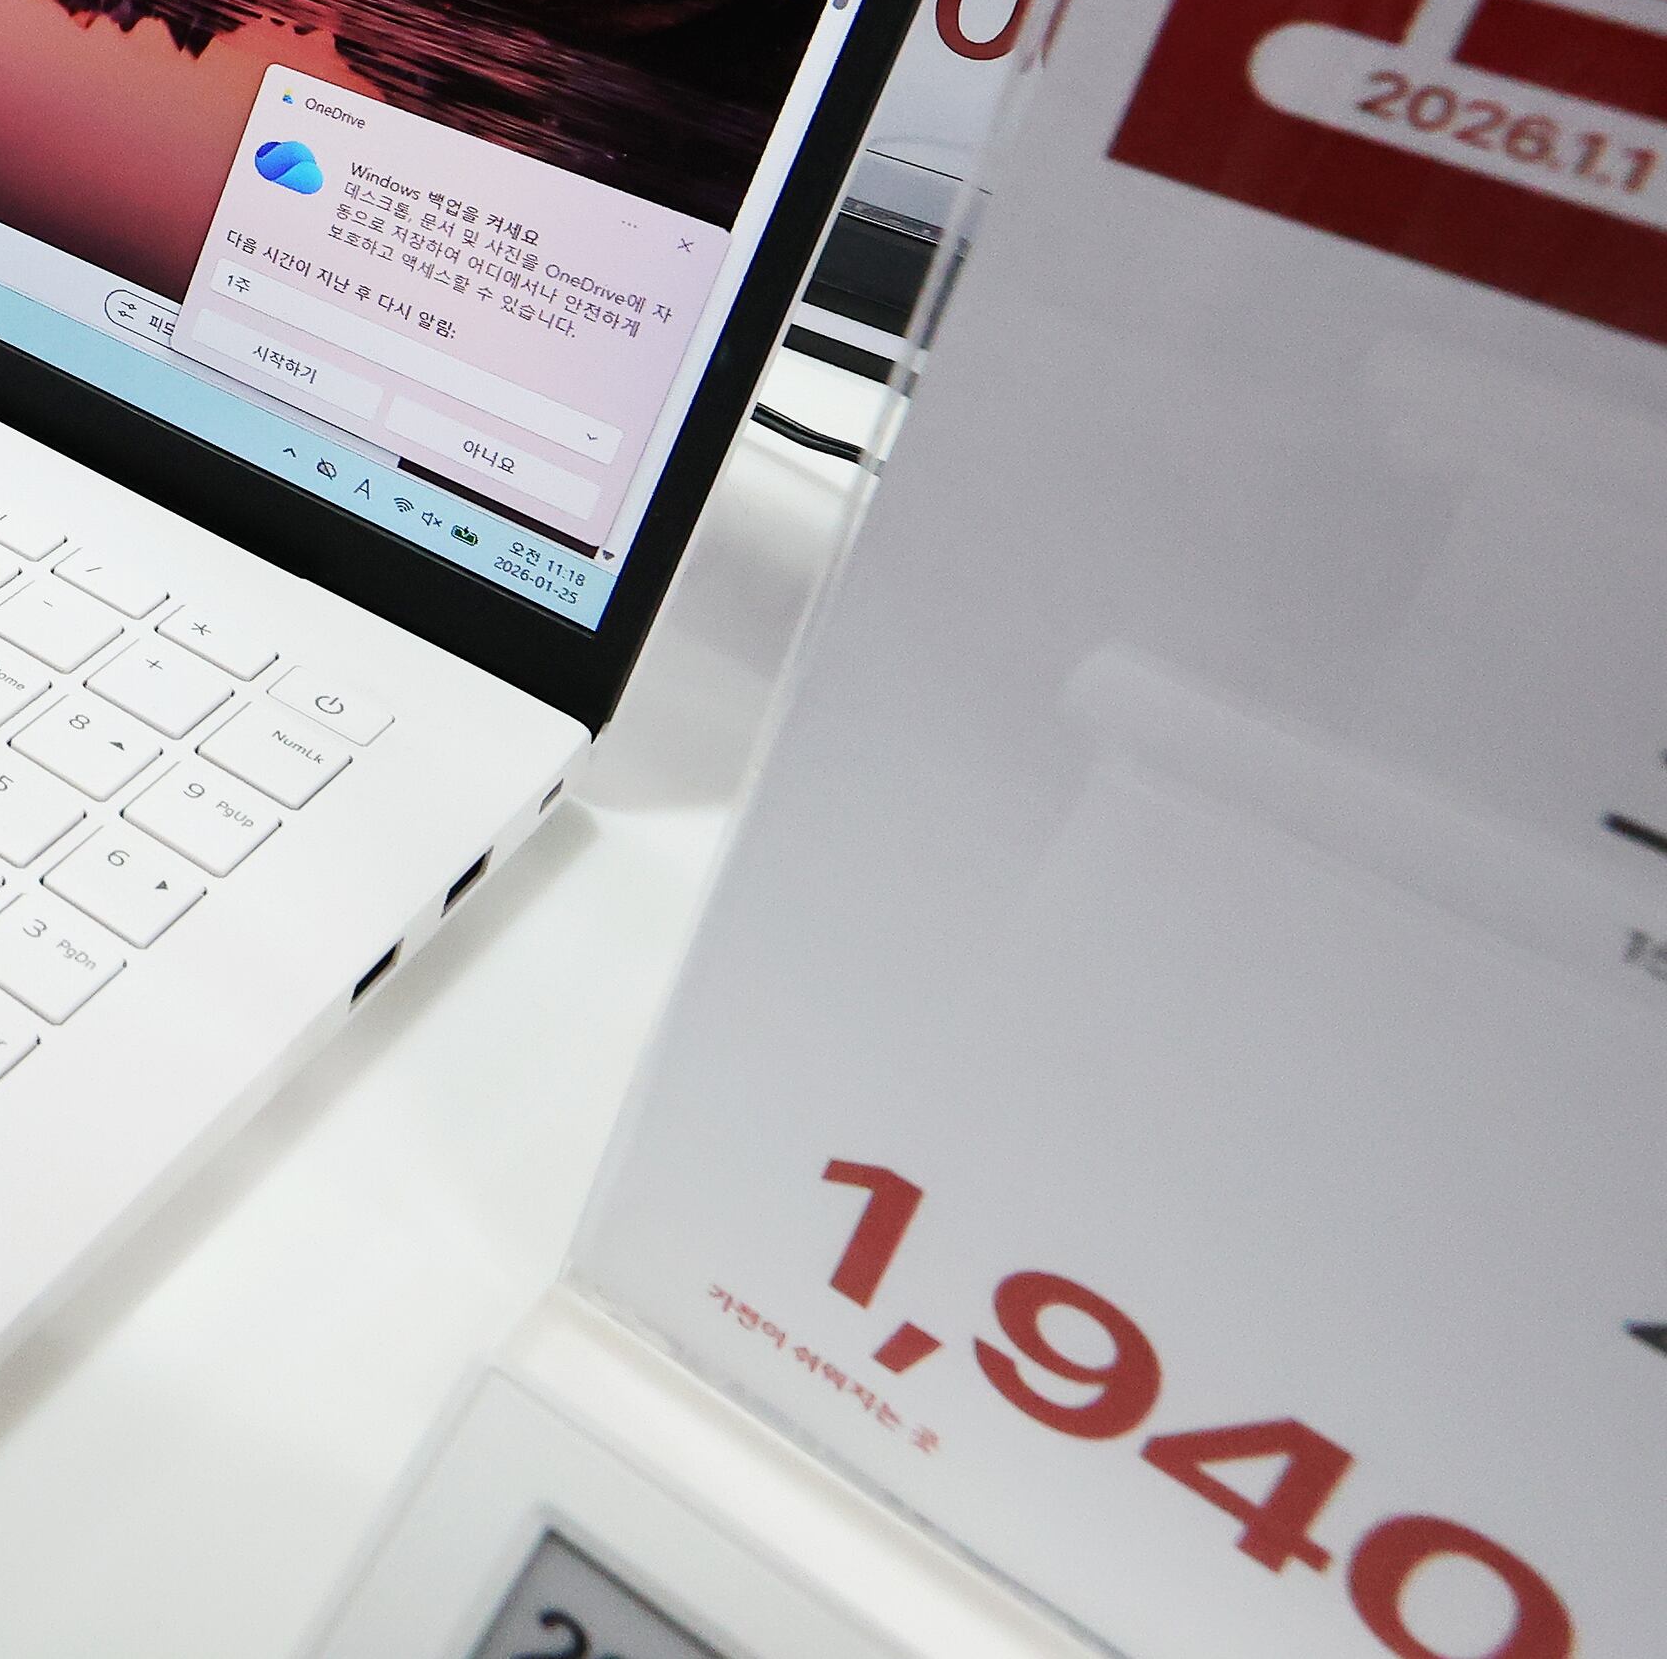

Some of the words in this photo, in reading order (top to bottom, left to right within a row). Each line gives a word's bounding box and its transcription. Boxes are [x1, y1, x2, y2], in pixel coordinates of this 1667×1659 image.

[304, 96, 366, 130] OneDrive
[1354, 69, 1661, 196] 2026.1.1
[350, 160, 421, 202] Windows
[427, 188, 480, 224] 백업을
[486, 212, 540, 248] 켜세요
[225, 230, 257, 255] 다음
[261, 244, 312, 279] 시간이
[316, 267, 349, 298] 지난
[356, 285, 371, 303] 후
[377, 291, 413, 321] 다시
[225, 272, 252, 295] 1주
[327, 222, 395, 263] 보호하고
[402, 250, 472, 293] 액세스할
[479, 285, 493, 301] 수
[501, 293, 577, 340] 있습니다.
[335, 200, 386, 235] 동으로
[392, 223, 462, 267] 저장하여
[467, 253, 559, 304] 어디에서나
[565, 289, 641, 339] 안전하게
[419, 209, 455, 240] 문서
[463, 228, 477, 246] 및
[484, 238, 539, 273] 사진을
[545, 263, 647, 315] OneDrive에
[658, 304, 674, 325] 자
[252, 343, 318, 386] 시작하기
[462, 438, 517, 475] 아니요
[353, 478, 372, 501] A
[493, 554, 579, 606] 2026-01-25
[508, 541, 542, 567] 오전
[546, 557, 587, 589] 11:18
[271, 728, 326, 766] NumLk
[214, 800, 255, 830] PgUp
[55, 938, 98, 971] PgDn
